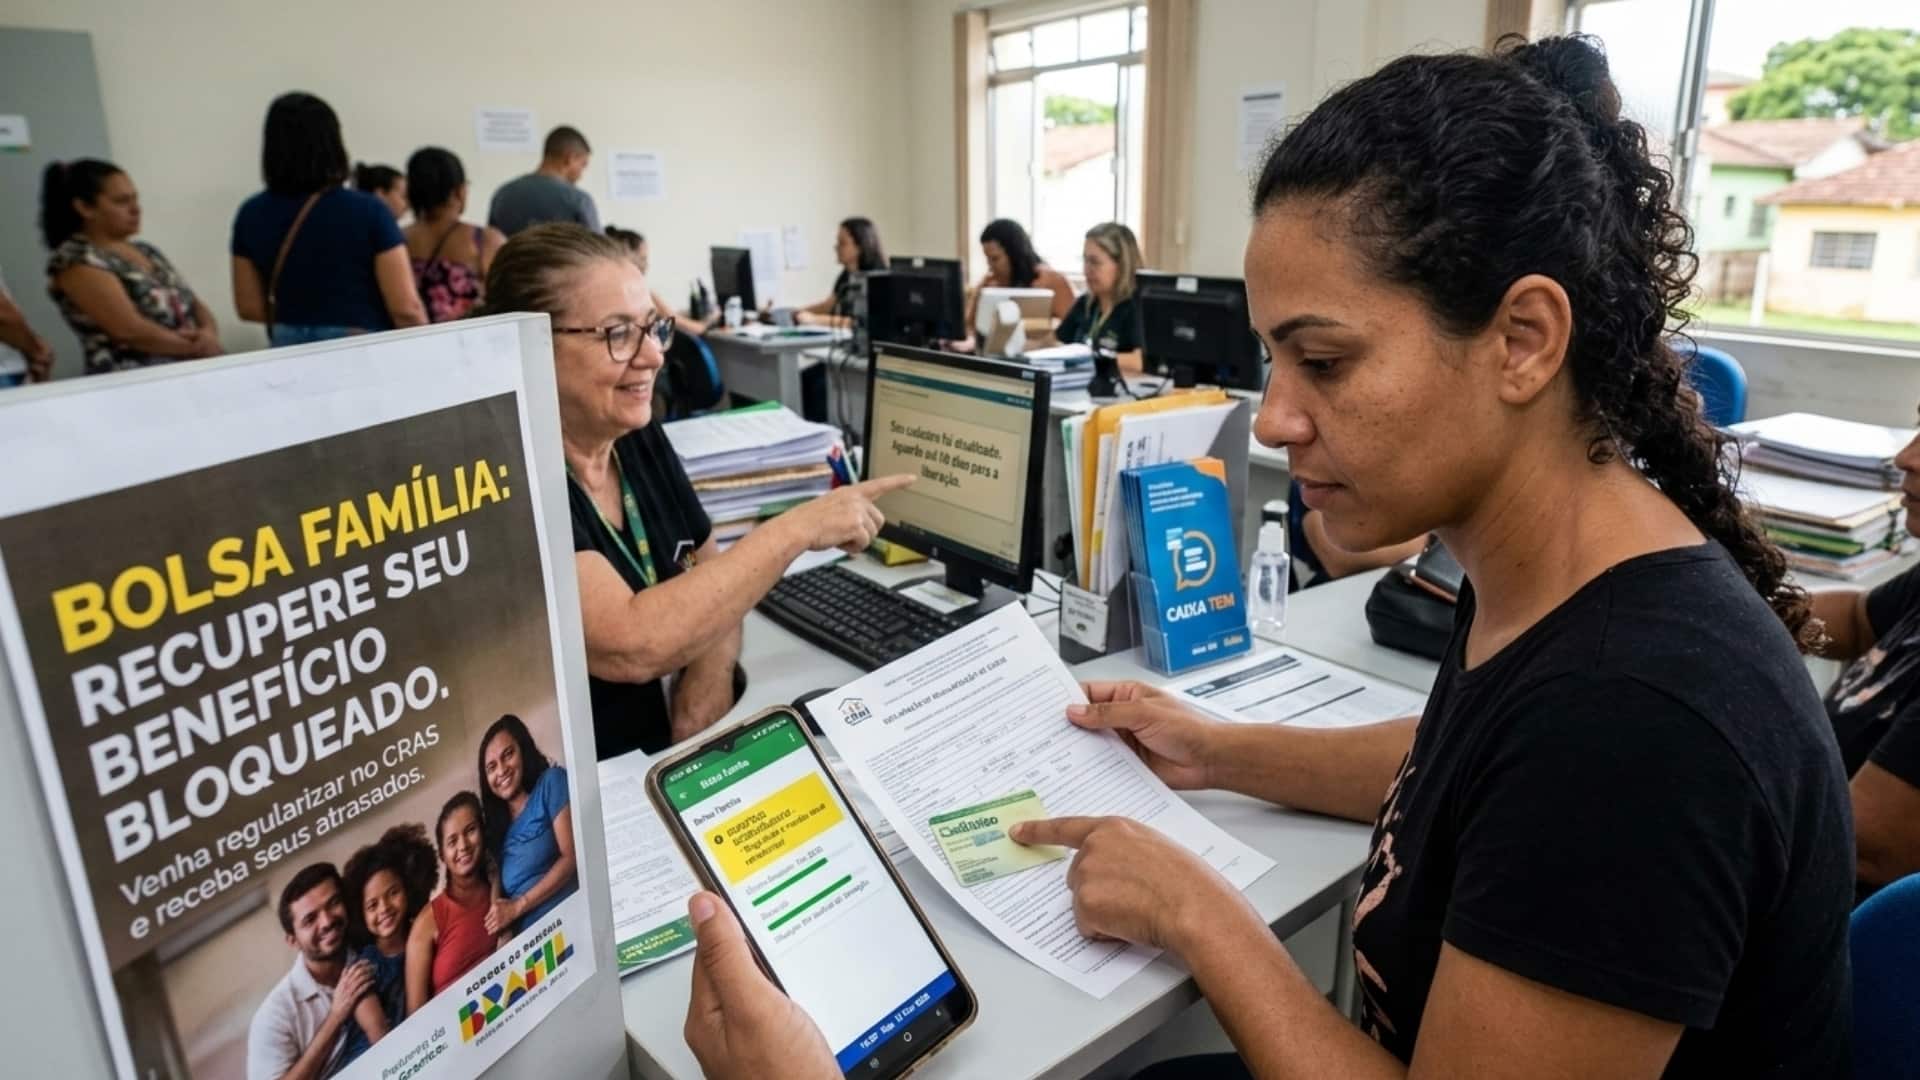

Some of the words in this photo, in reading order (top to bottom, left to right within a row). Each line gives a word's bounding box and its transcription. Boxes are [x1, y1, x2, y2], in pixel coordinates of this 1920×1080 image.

[52, 525, 294, 653] BOLSA
[300, 459, 511, 568] FAMÍLIA:
[71, 564, 377, 727] RECUPERE
[383, 529, 470, 599] SEU
[1166, 599, 1207, 622] CAIXA
[88, 627, 387, 796] BENEFÍCIO
[104, 666, 450, 863] BLOQUEADO.
[119, 848, 212, 905] Venha
[216, 775, 345, 872] regularizar
[350, 761, 379, 788] no
[382, 724, 440, 767] CRAS
[130, 916, 150, 939] e
[155, 861, 249, 927] receba
[253, 829, 311, 870] seus
[315, 766, 426, 836] atrasados.
